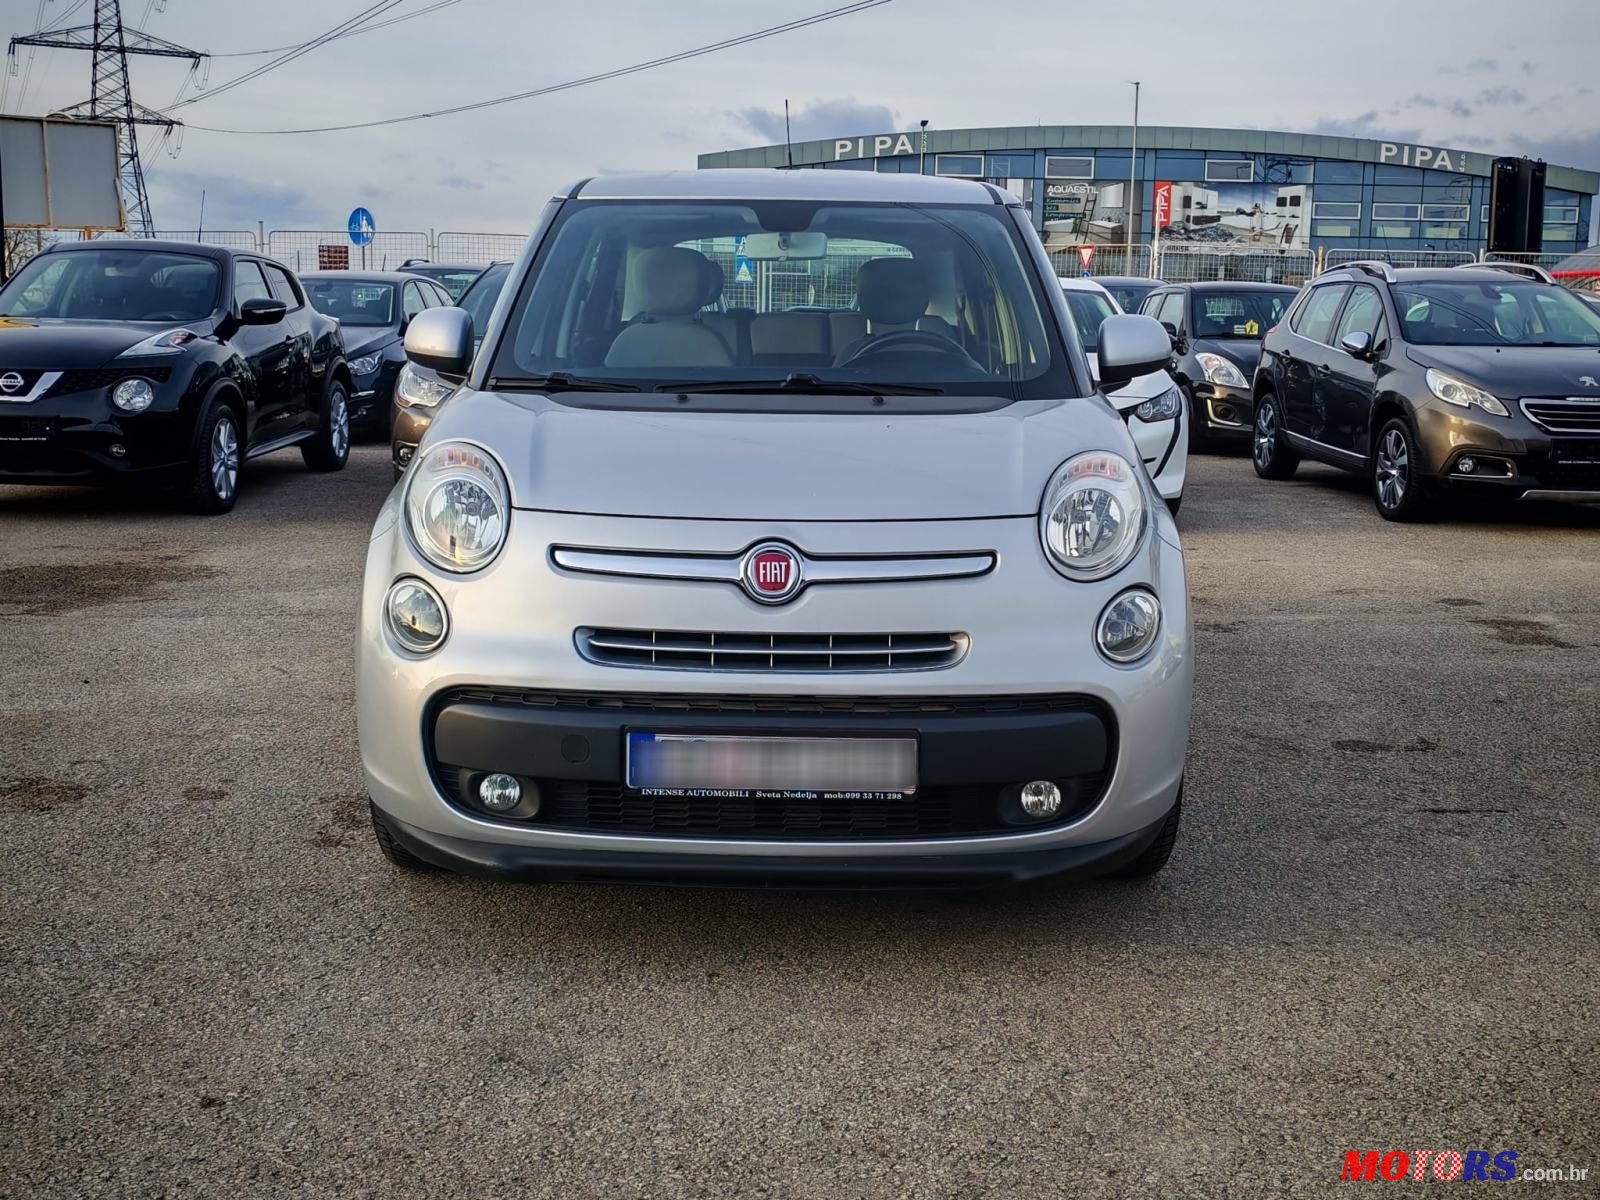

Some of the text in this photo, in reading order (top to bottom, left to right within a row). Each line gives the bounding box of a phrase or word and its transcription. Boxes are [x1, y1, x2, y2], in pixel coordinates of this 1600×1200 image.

[834, 133, 914, 161] PIPA
[1380, 143, 1453, 171] PIPA
[1047, 184, 1099, 195] AQUAESTIL
[1159, 185, 1169, 222] PIPA
[759, 561, 788, 583] FIAT
[641, 788, 685, 796] INTENSE
[686, 789, 749, 798] AUTOMOBILI
[756, 790, 781, 798] Sveta
[783, 790, 817, 800] Nedelja
